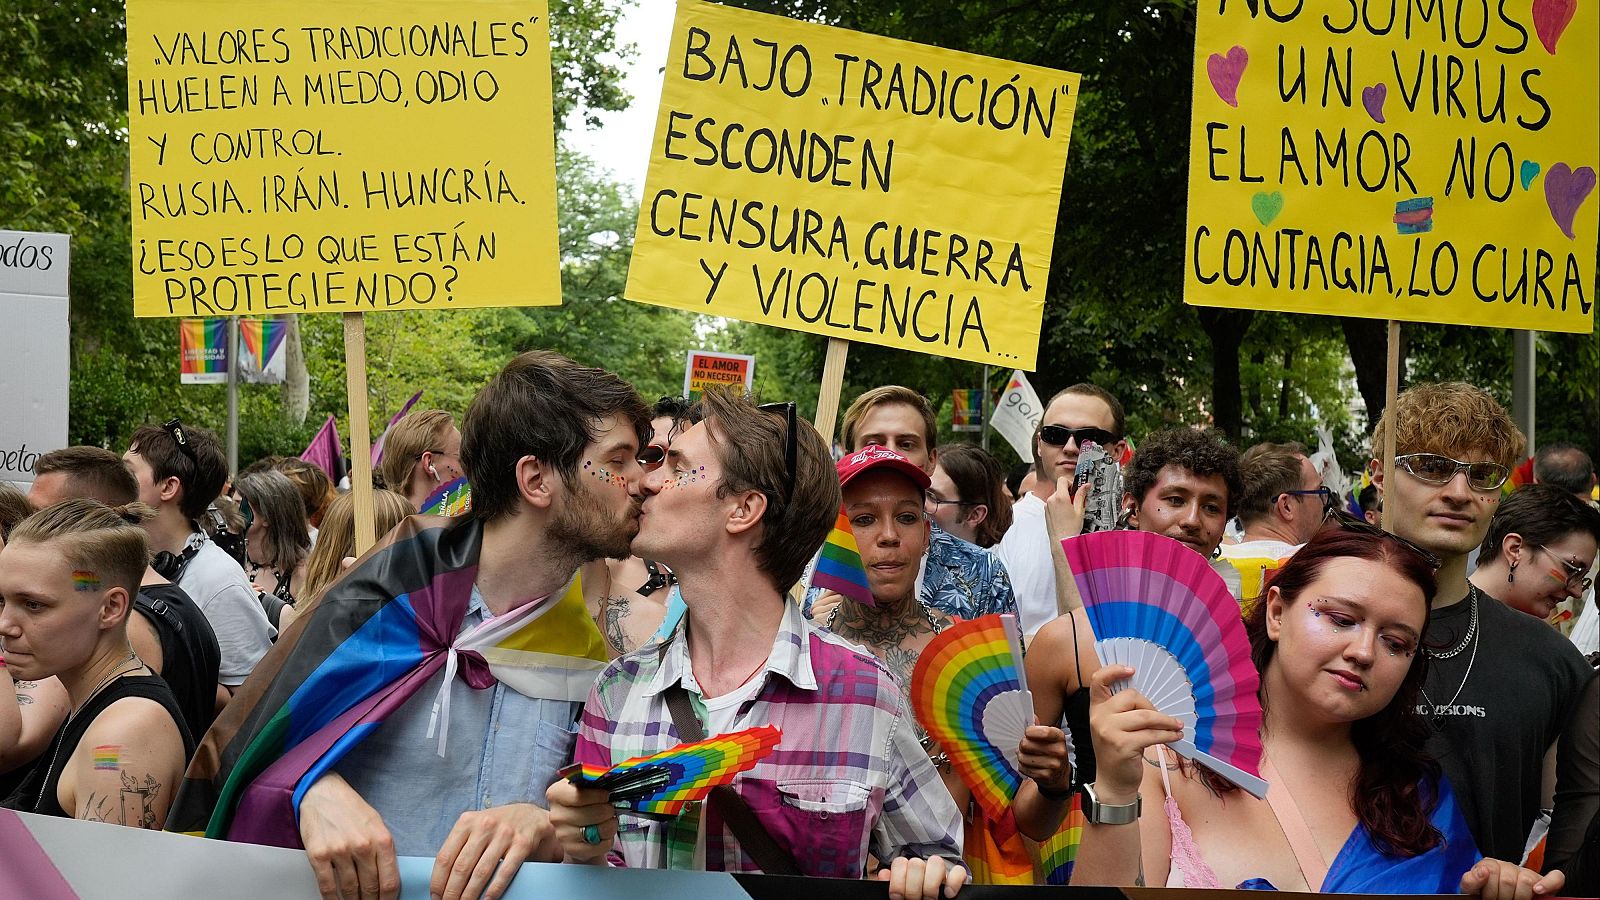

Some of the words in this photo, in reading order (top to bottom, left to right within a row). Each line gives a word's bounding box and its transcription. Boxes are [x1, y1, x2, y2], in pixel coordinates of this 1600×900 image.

[1323, 0, 1529, 54] SOMOS
[683, 26, 812, 97] BAJO
[139, 75, 257, 115] HUELEN
[273, 73, 292, 105] A
[304, 69, 408, 108] MIEDO,
[416, 70, 499, 104] ODIO
[1278, 44, 1352, 108] UN
[1392, 49, 1552, 131] VIRUS
[147, 132, 167, 165] Y
[190, 129, 342, 165] CONTROL.
[664, 111, 894, 192] ESCONDEN
[1206, 122, 1264, 183] EL
[1279, 127, 1418, 195] AMOR
[1445, 136, 1515, 202] NO
[139, 179, 252, 220] RUSIA.
[263, 168, 349, 213] IRÁN.
[362, 161, 526, 210] HUNGRÍA.
[0, 237, 53, 270] dos
[222, 237, 259, 266] ES
[265, 233, 304, 263] LO
[317, 234, 379, 265] QUE
[394, 222, 496, 263] ESTÁN
[650, 189, 859, 270] CENSURA,
[864, 220, 1032, 292] GUERRA
[165, 265, 459, 315] PROTEGIENDO?
[699, 259, 728, 304] Y
[1194, 226, 1402, 298] CONTAGIA,
[1408, 237, 1459, 298] LO
[1472, 244, 1592, 314] CURA
[694, 370, 705, 379] NO
[707, 372, 742, 382] NECESITA
[698, 358, 708, 369] EL
[712, 360, 739, 372] AMOR
[0, 443, 41, 476] eta
[1434, 704, 1486, 718] VISIONS
